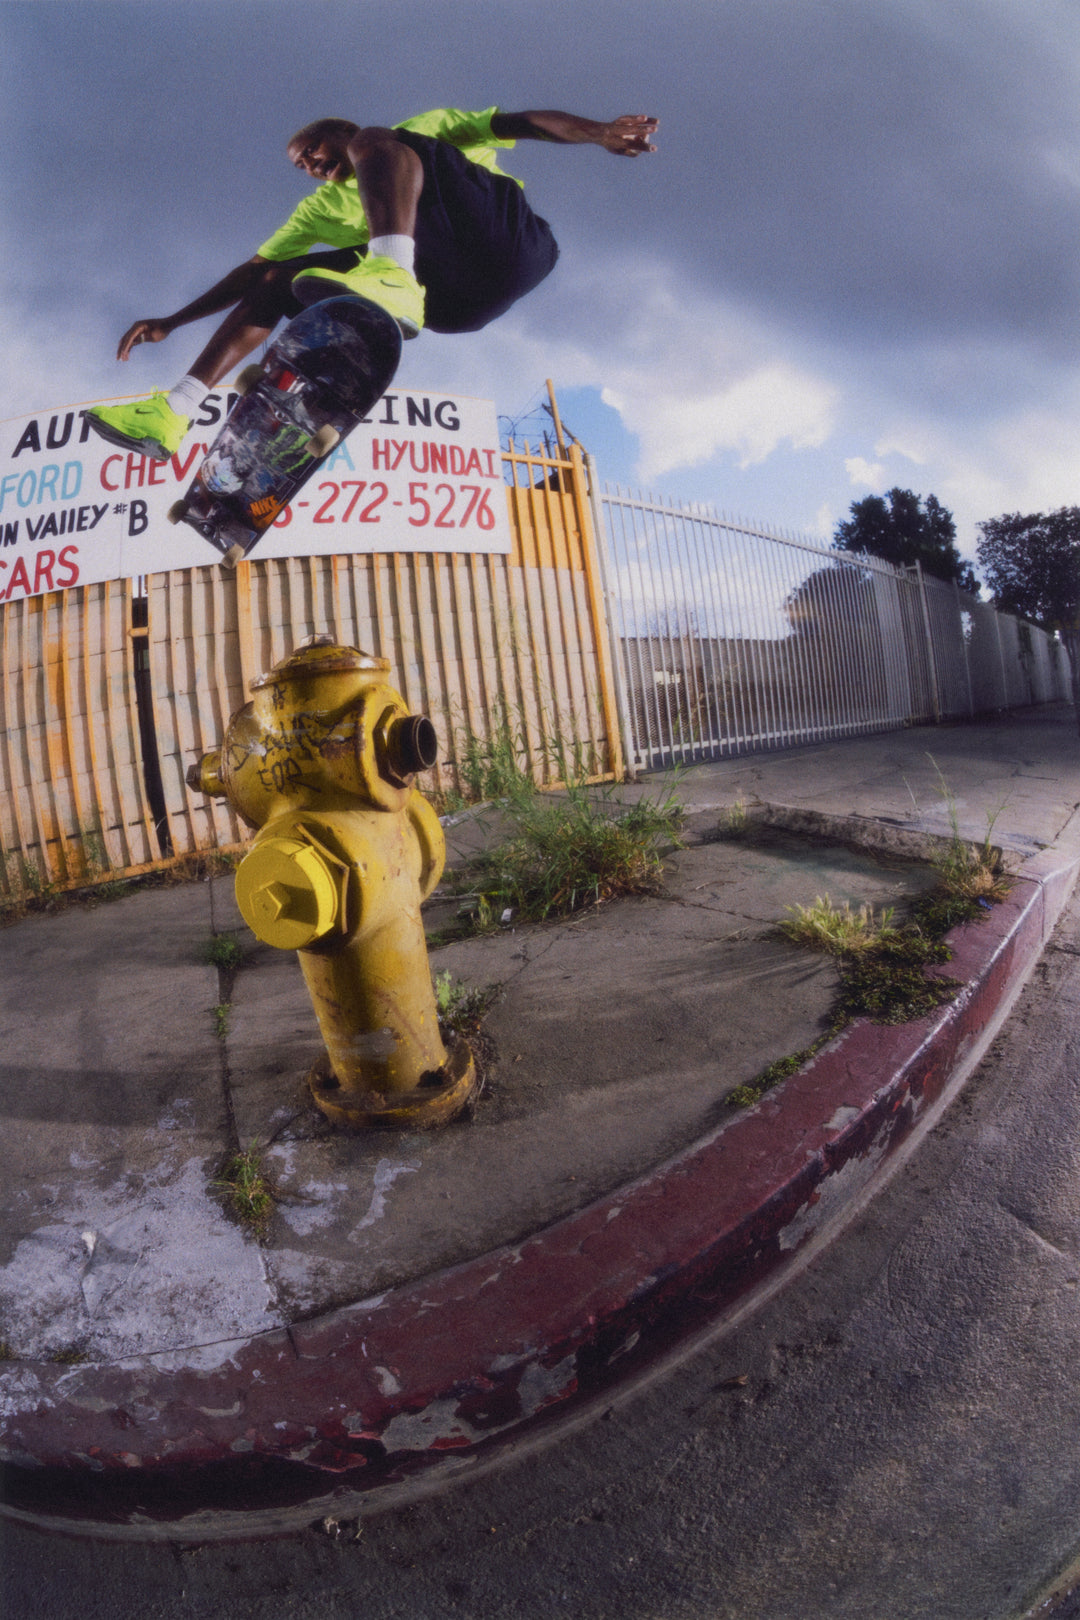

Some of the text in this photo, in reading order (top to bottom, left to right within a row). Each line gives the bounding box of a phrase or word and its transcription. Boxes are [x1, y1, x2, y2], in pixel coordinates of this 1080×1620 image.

[11, 410, 97, 458] AUT
[0, 460, 83, 513] FORD
[372, 438, 500, 479] HYUNDAI
[250, 495, 278, 517] NIKE
